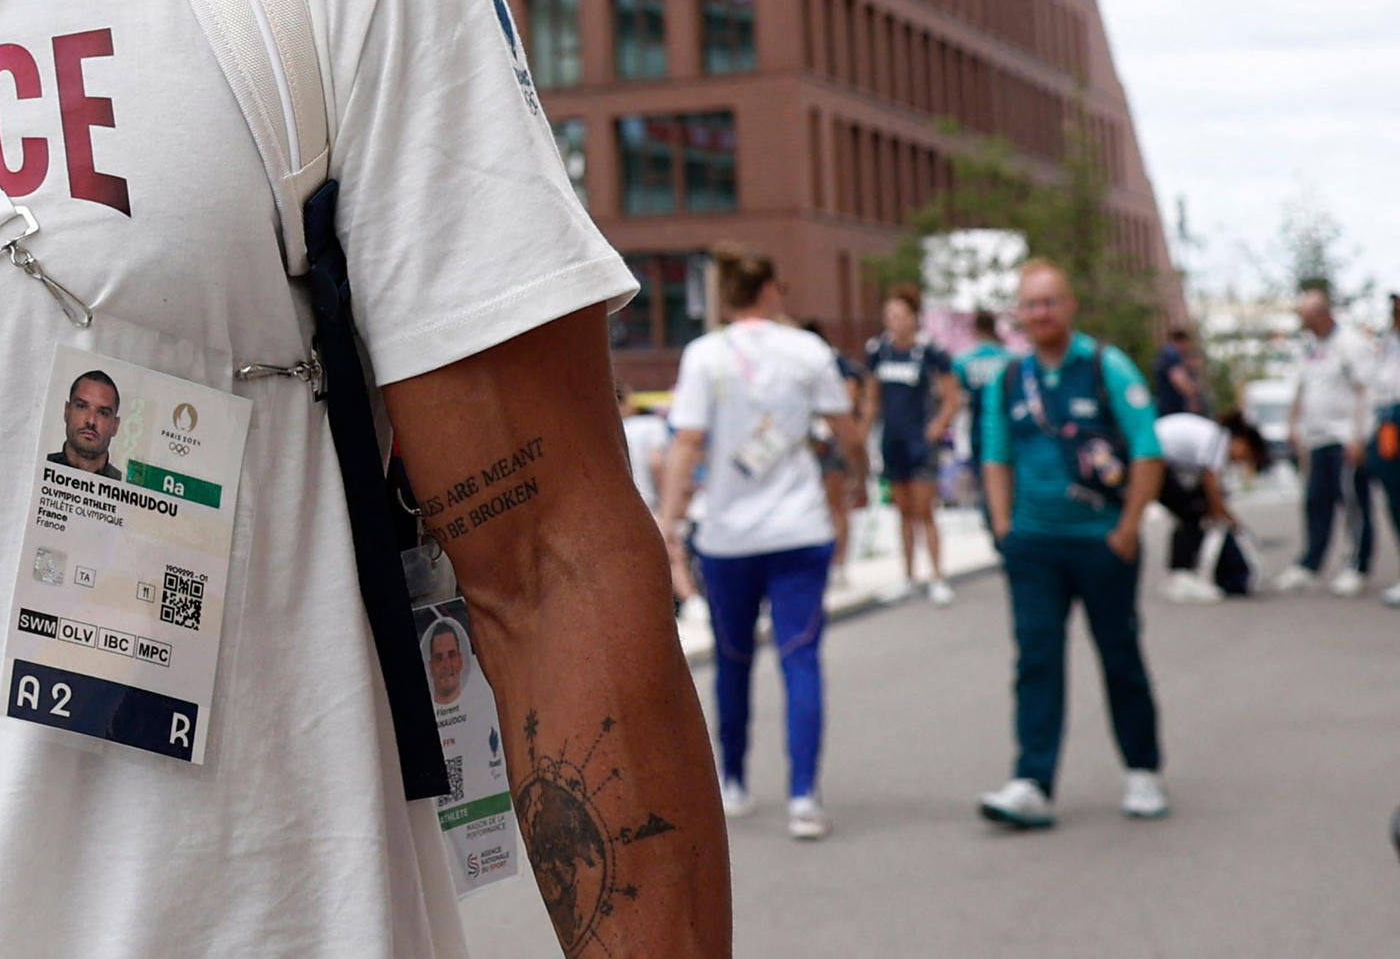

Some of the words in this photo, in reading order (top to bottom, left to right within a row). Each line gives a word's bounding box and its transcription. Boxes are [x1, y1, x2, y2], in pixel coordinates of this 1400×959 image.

[160, 429, 181, 442] PARIS
[446, 475, 480, 507] ARE
[481, 437, 545, 487] MEANT
[43, 468, 96, 495] Florent
[98, 482, 179, 518] MANAUDOU
[162, 475, 185, 497] Aa
[41, 486, 82, 504] OLYMPIC
[83, 497, 117, 514] ATHLETE
[447, 517, 469, 539] BE
[468, 476, 540, 528] BROKEN
[36, 516, 66, 532] France
[38, 507, 69, 522] France
[75, 506, 124, 527] OLYMPIQUE
[79, 571, 91, 582] TA
[19, 614, 57, 636] SWM
[62, 624, 93, 643] OLV
[104, 634, 129, 652] IBC
[138, 642, 169, 663] MPC
[16, 674, 41, 711] A
[49, 682, 72, 718] 2
[169, 711, 191, 748] R
[436, 704, 460, 717] Florent
[481, 846, 502, 857] AGENCE
